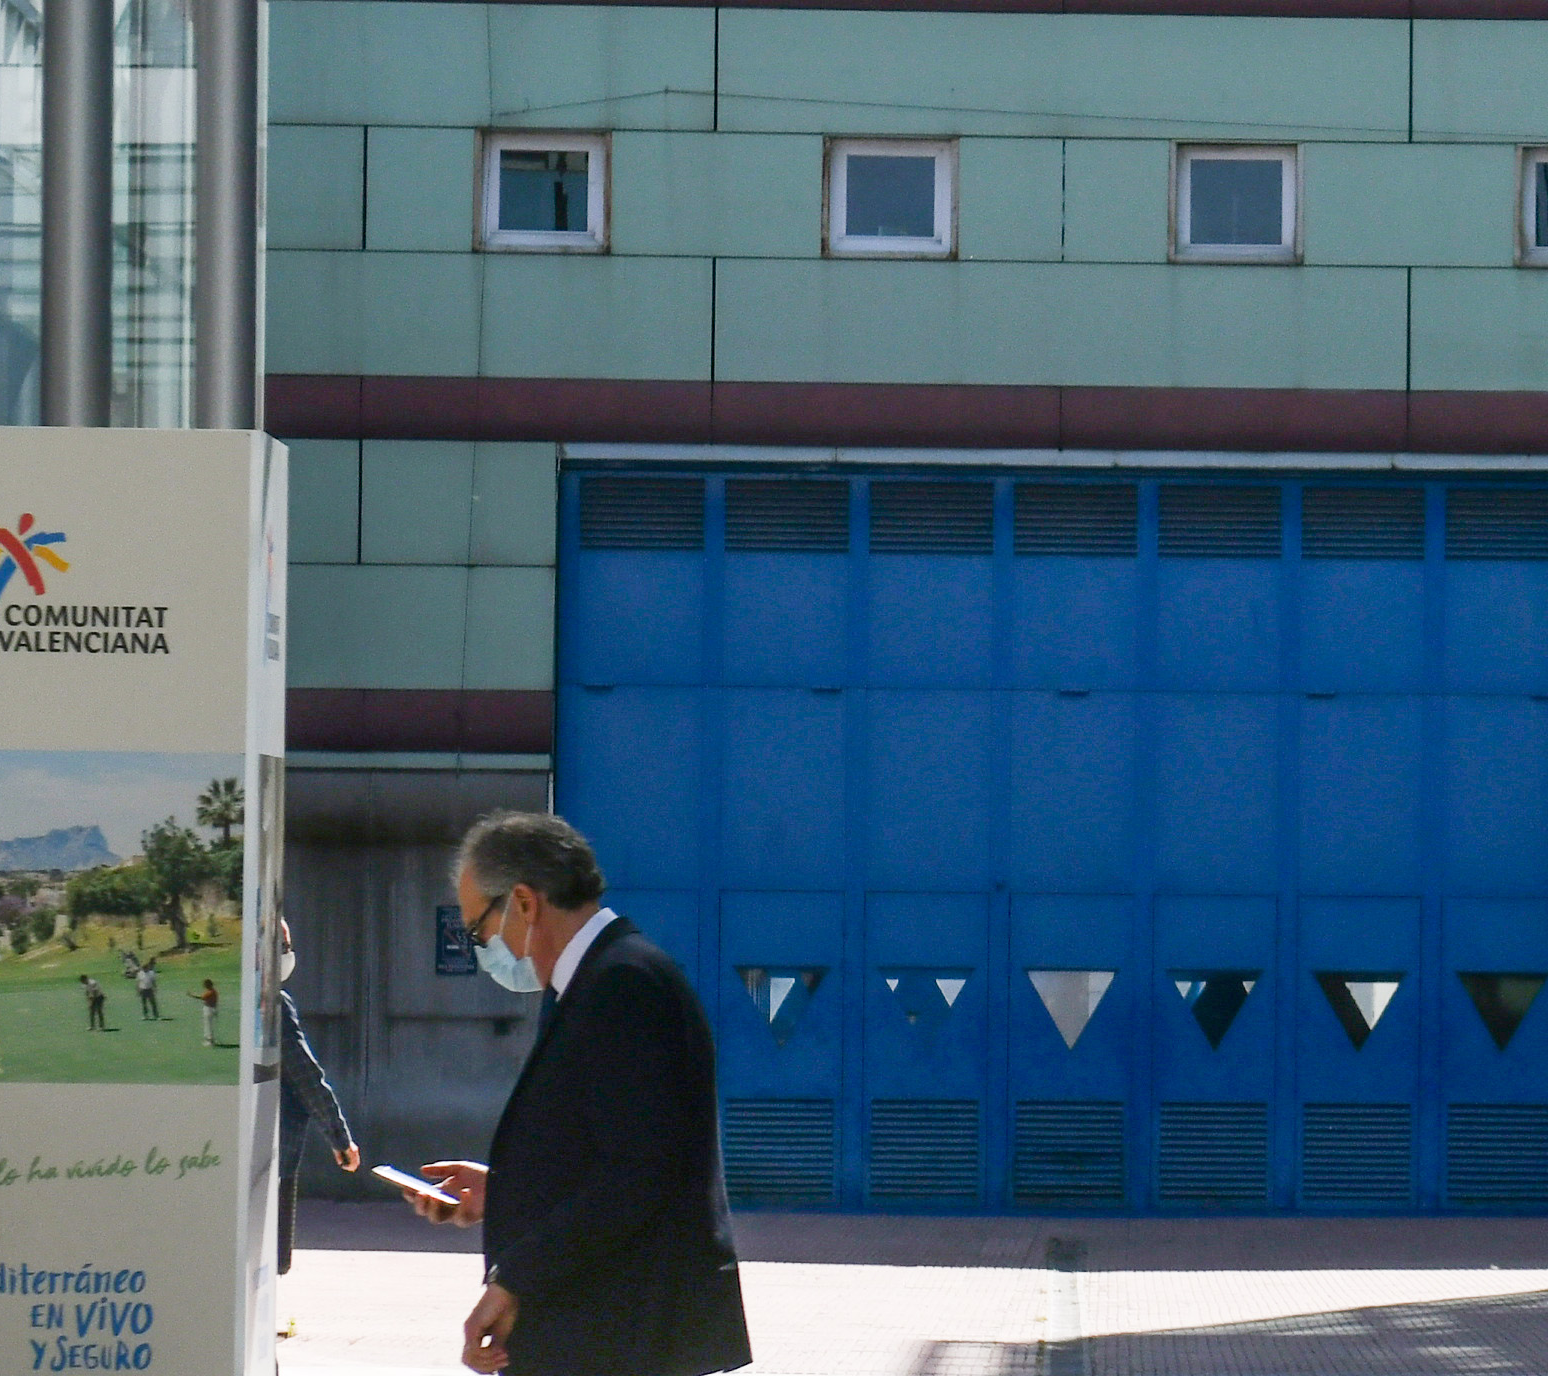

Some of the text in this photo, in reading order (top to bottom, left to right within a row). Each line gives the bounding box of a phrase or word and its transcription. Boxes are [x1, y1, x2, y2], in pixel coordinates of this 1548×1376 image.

[4, 604, 168, 629] COMUNITAT
[27, 1155, 59, 1182] ha
[66, 1154, 137, 1180] vivido
[144, 1147, 173, 1176] lo
[178, 1140, 222, 1180] sabe
[32, 1304, 63, 1330] EN
[31, 1339, 47, 1371] Y
